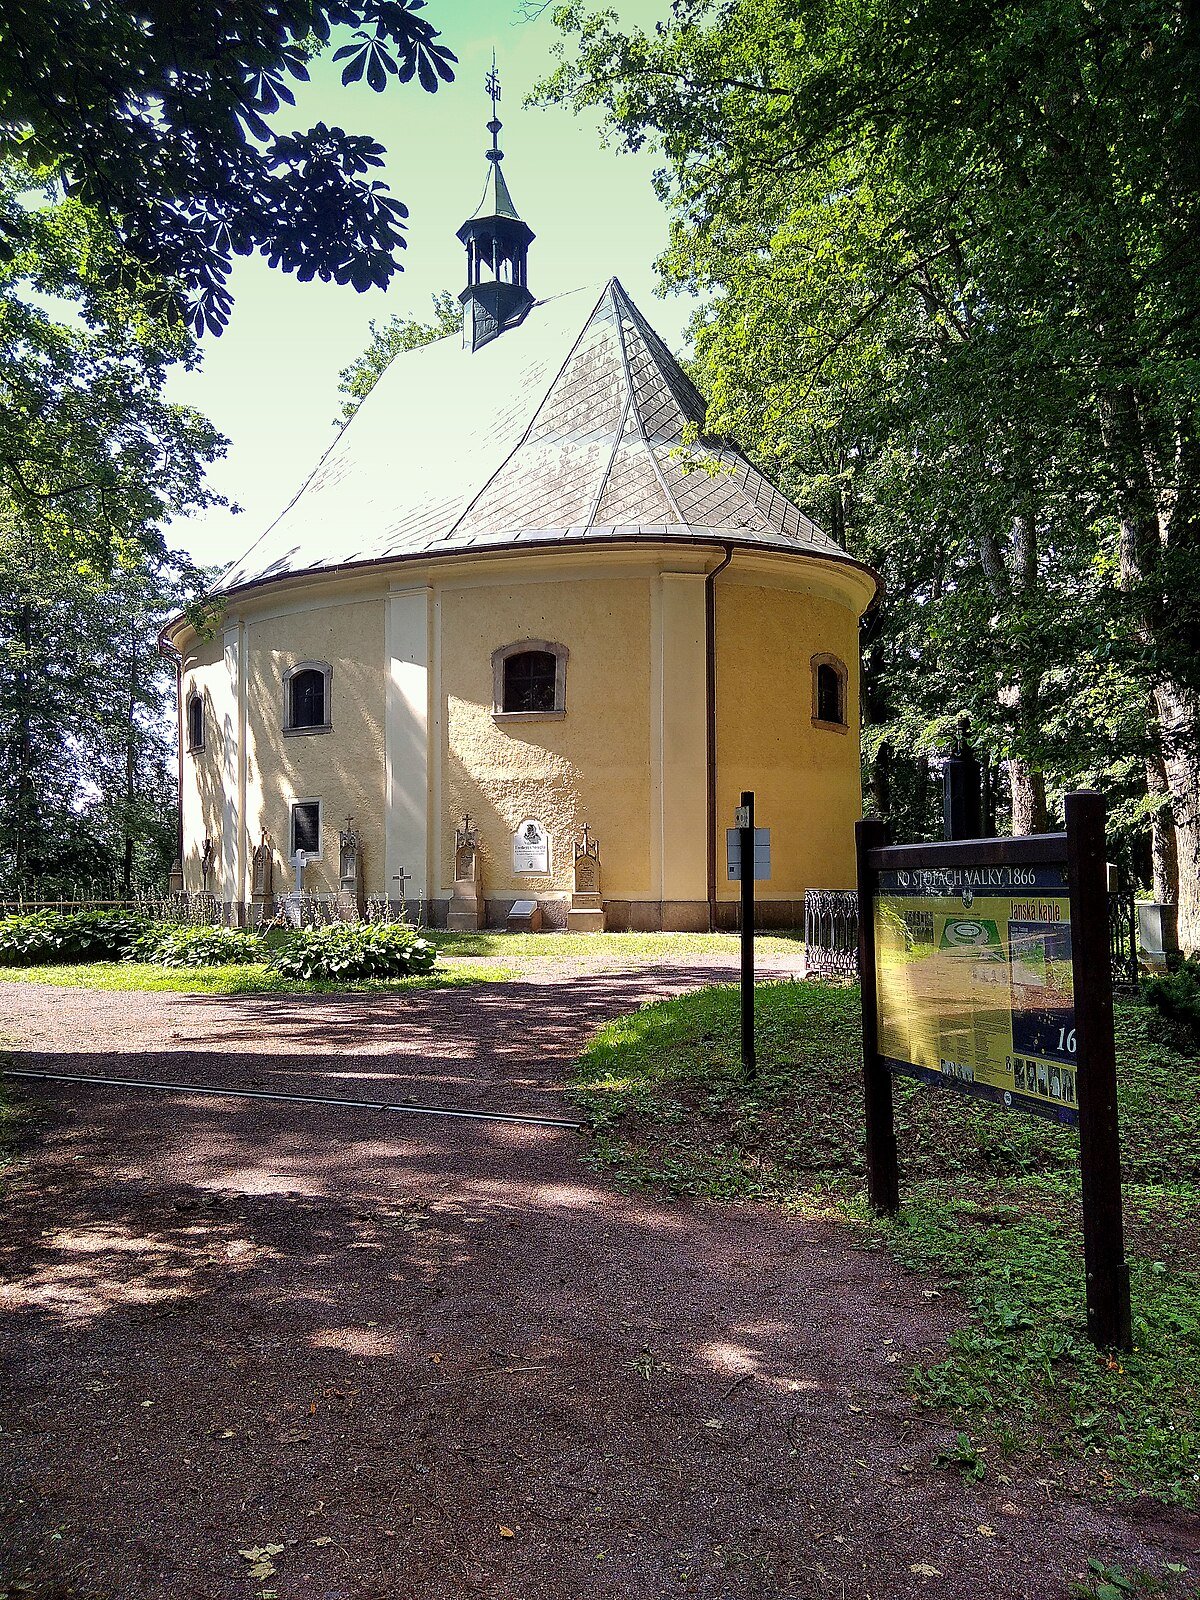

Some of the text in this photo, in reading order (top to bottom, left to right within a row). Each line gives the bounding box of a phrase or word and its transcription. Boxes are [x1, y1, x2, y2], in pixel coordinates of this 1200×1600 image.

[1007, 867, 1036, 885] 1866
[1009, 899, 1061, 924] Janská kaple
[1056, 1026, 1077, 1054] 16
